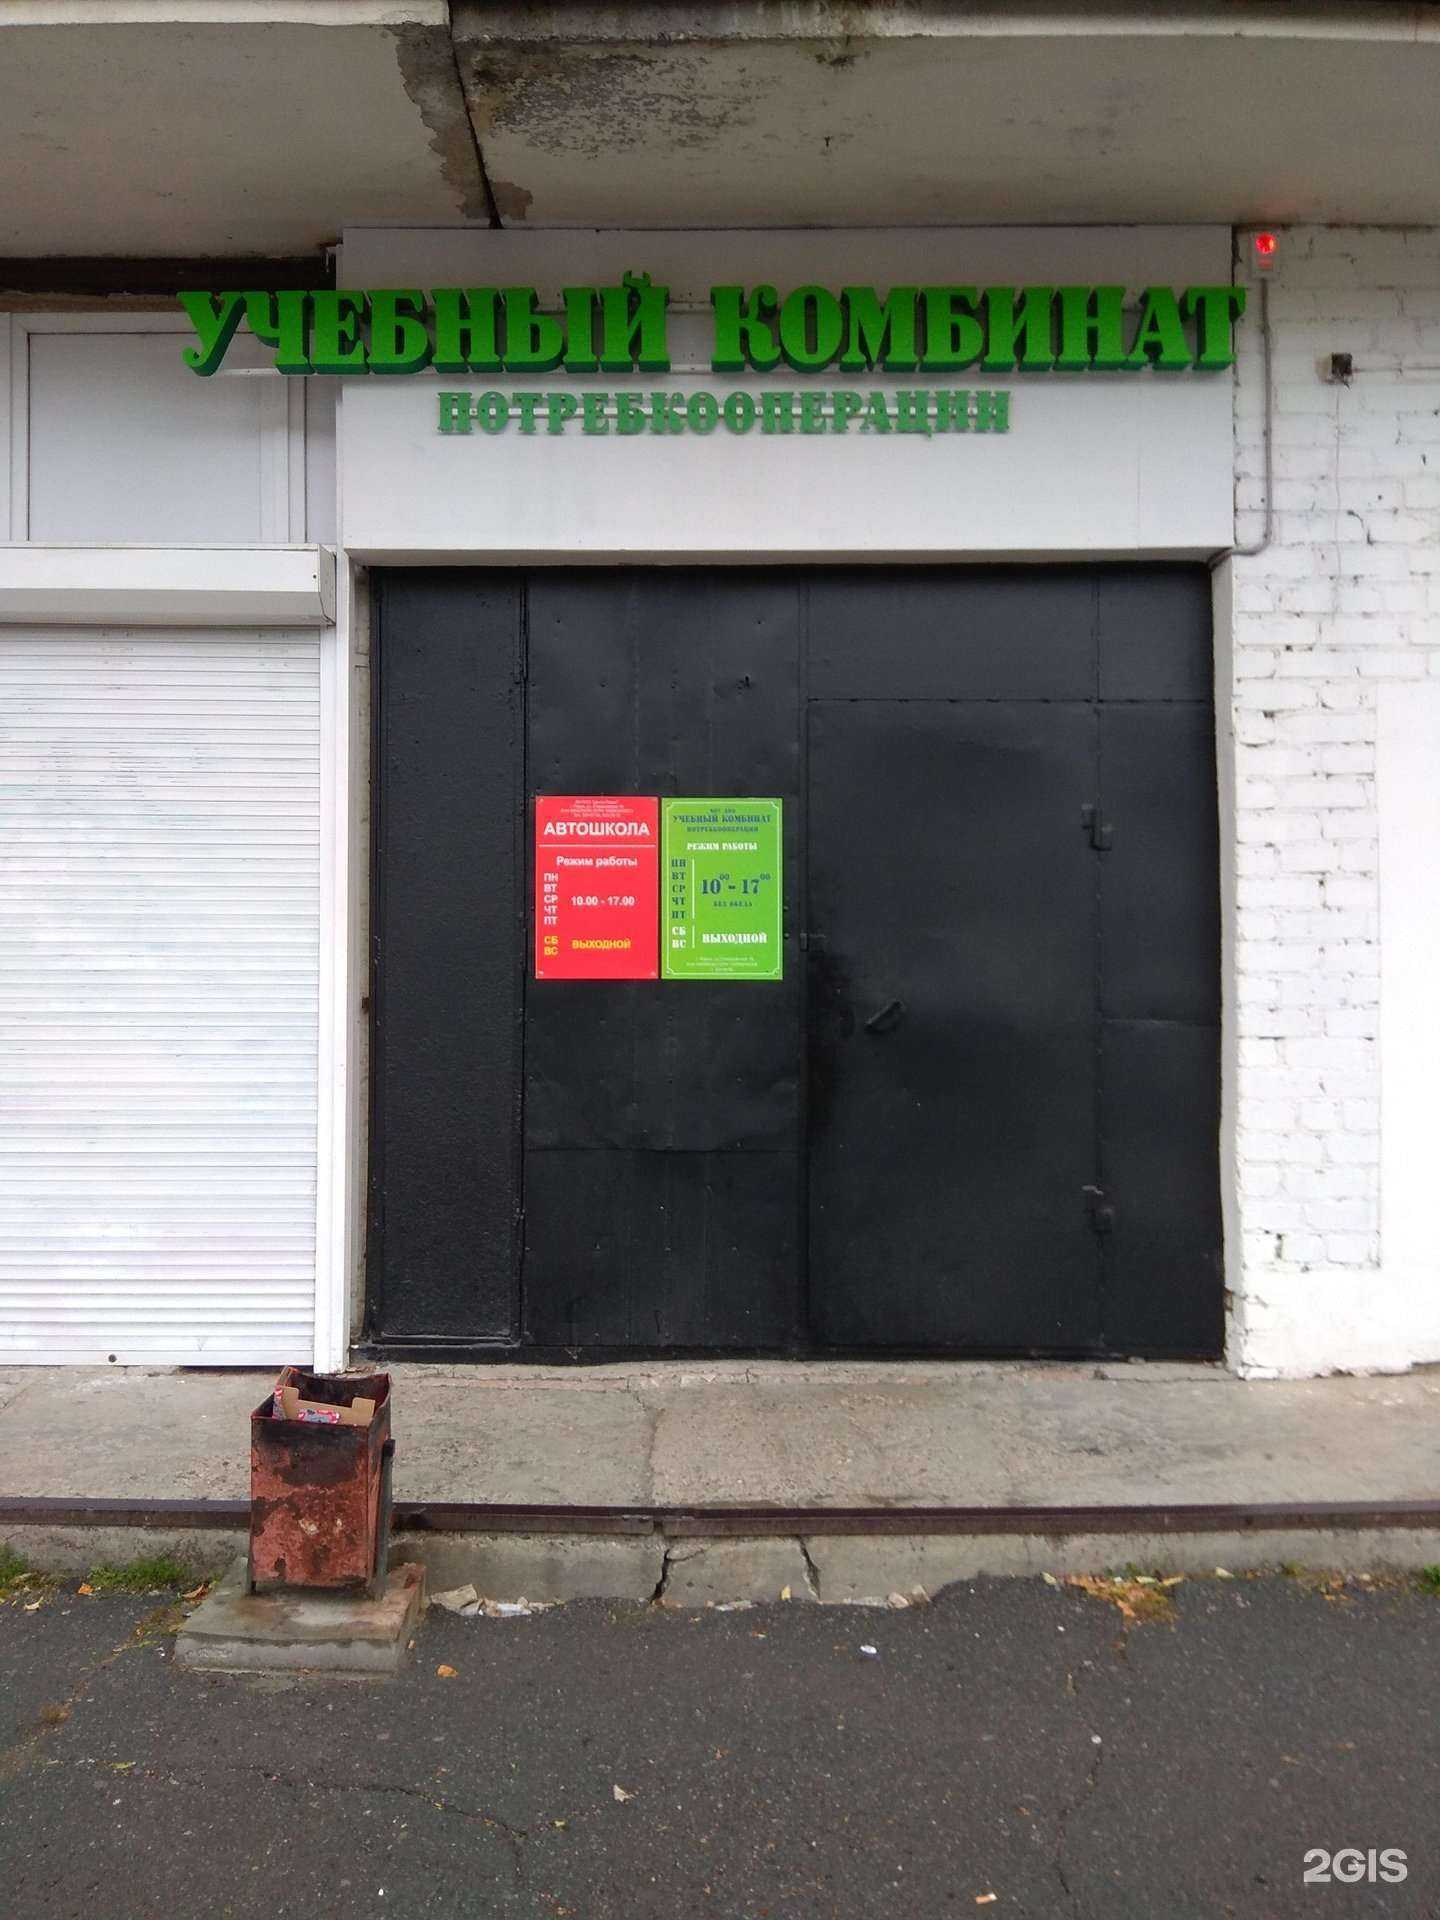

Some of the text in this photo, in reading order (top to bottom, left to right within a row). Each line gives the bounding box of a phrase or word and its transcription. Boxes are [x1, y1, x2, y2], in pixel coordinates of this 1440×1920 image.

[176, 270, 1246, 377] УЧЕБНЫЙ КОМБИНАТ
[437, 390, 1010, 437] ПОТРЕБКООПЕРАЦИИ
[673, 814, 771, 823] УЧЕБНЫЙ КОМБИНАТ
[543, 821, 650, 836] АВТОШКОЛА
[687, 842, 757, 850] РЕЖИМ РАБОТЫ
[556, 856, 638, 868] Режим работы
[672, 859, 686, 868] ПН
[543, 872, 559, 882] ПН
[672, 872, 685, 880] ВТ
[543, 883, 558, 893] ВТ
[672, 884, 685, 893] СР
[543, 894, 558, 904] СР
[571, 895, 599, 906] 10.00
[607, 895, 636, 906] 17.00
[672, 896, 685, 905] ЧТ
[543, 905, 558, 914] ЧТ
[672, 910, 685, 919] ПТ
[543, 916, 558, 925] ПТ
[672, 926, 686, 936] СБ
[543, 935, 559, 945] СБ
[702, 932, 767, 945] ВЫХОДНОЙ
[571, 938, 631, 950] ВЫХОДНОЙ
[672, 939, 686, 949] ВС
[543, 946, 559, 956] ВС
